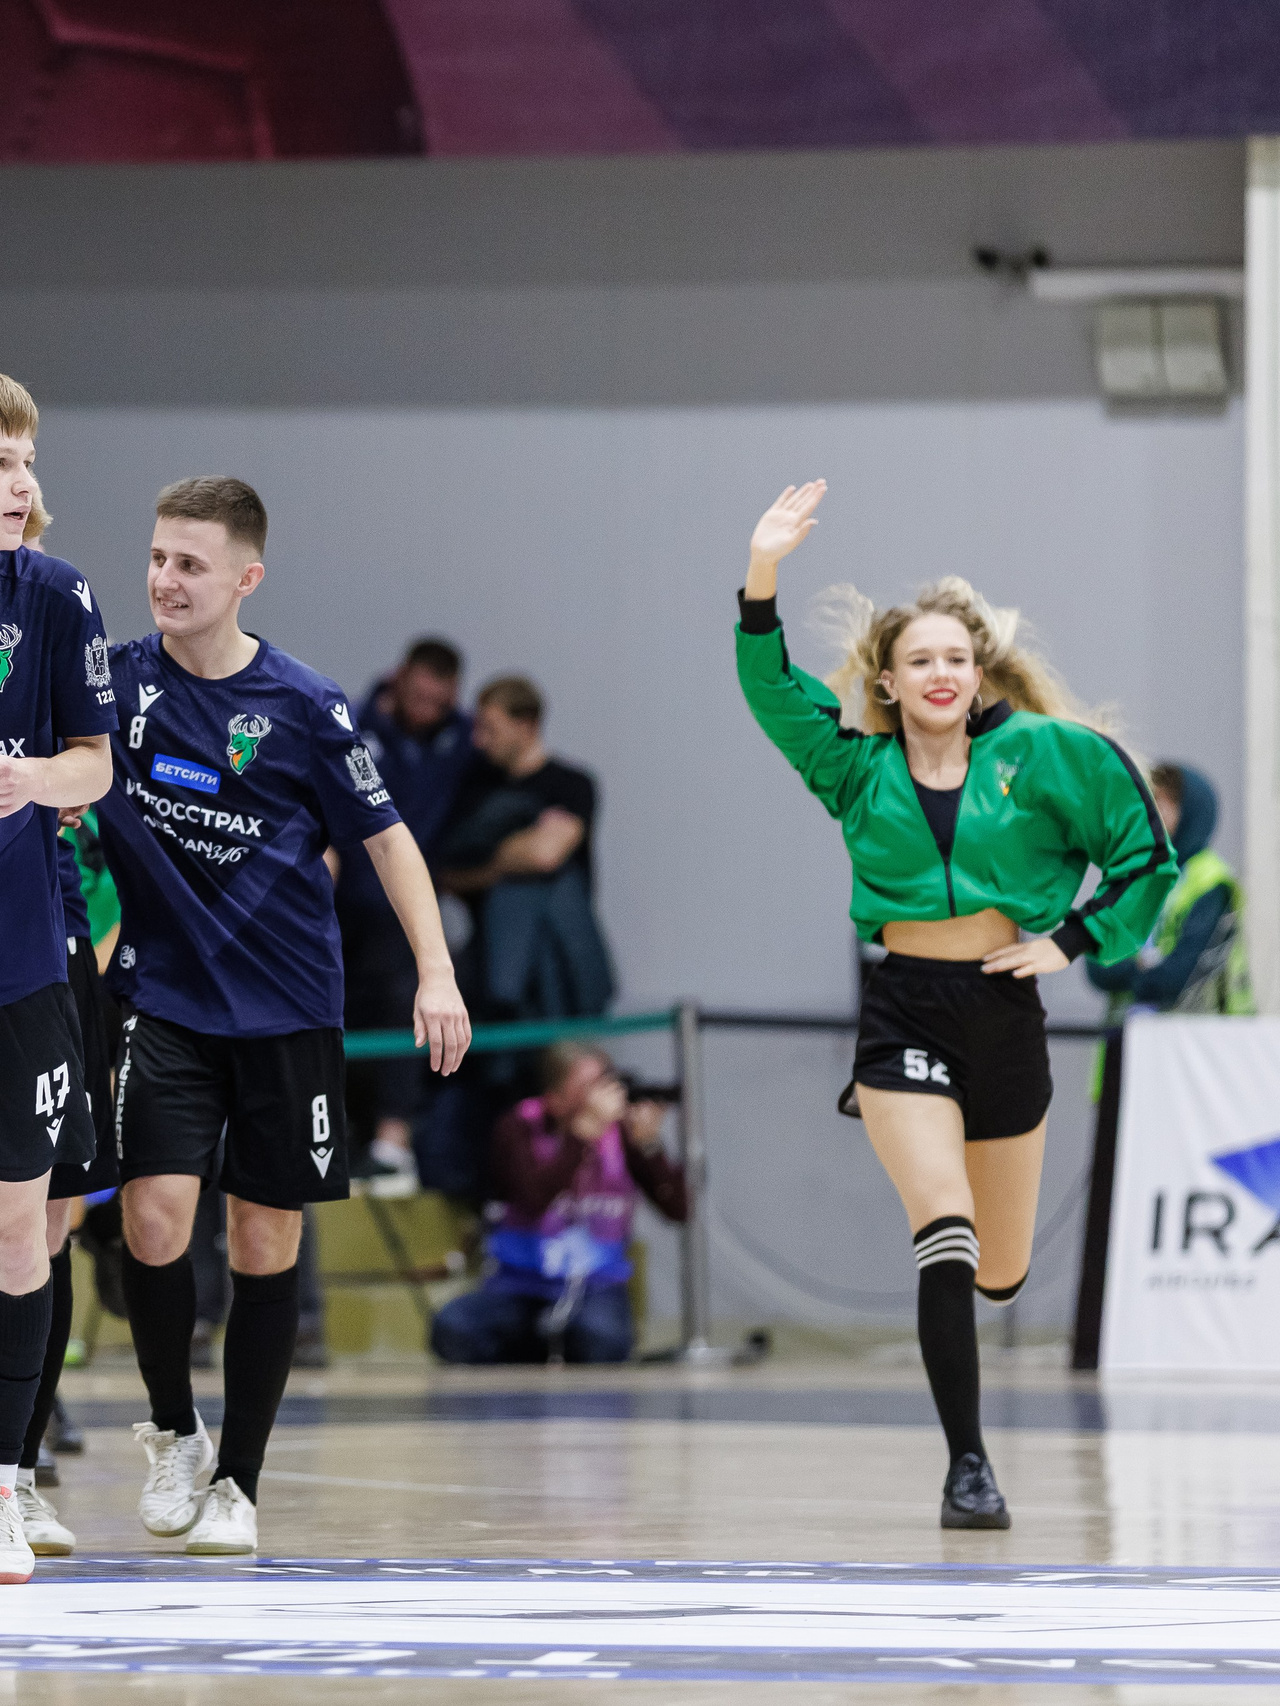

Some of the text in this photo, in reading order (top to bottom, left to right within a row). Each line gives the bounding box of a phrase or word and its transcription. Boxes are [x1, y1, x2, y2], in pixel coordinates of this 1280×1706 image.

[128, 715, 148, 750] 8
[154, 762, 219, 786] БЕТСИТИ
[367, 788, 391, 806] 1221
[35, 1061, 71, 1118] 47
[311, 1094, 331, 1143] 8
